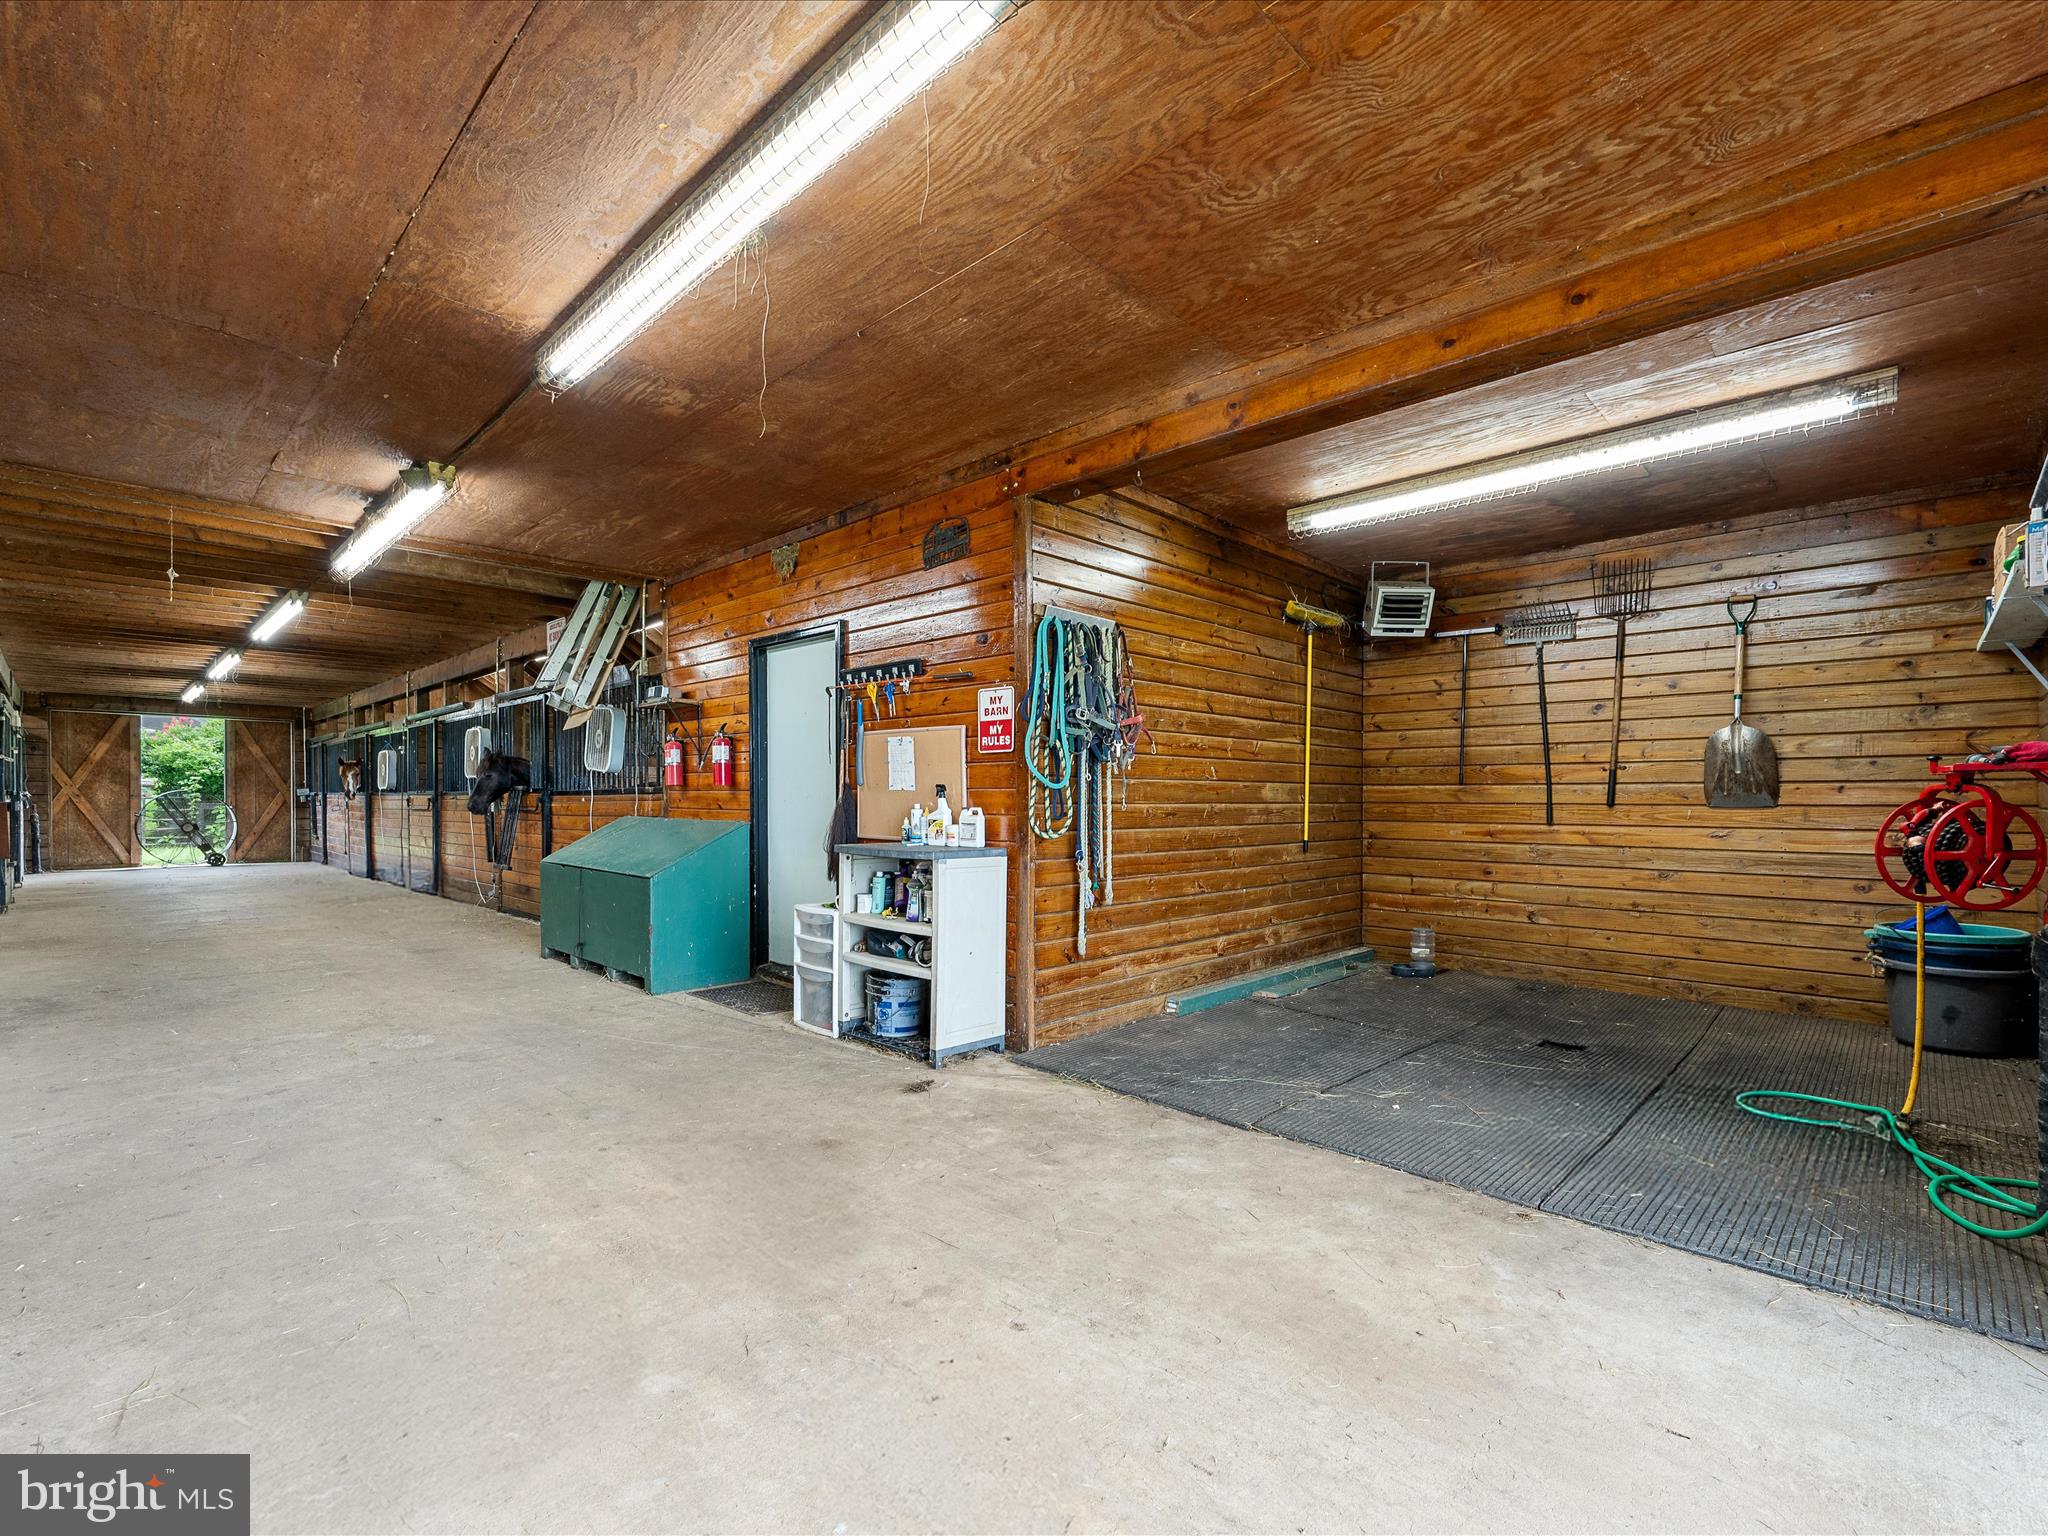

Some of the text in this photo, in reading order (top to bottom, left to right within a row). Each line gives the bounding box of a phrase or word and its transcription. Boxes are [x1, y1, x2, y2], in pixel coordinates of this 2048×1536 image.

[990, 696, 1002, 705] MY
[984, 706, 1008, 716] BARN
[989, 724, 1003, 735] MY
[982, 735, 1010, 746] RULES
